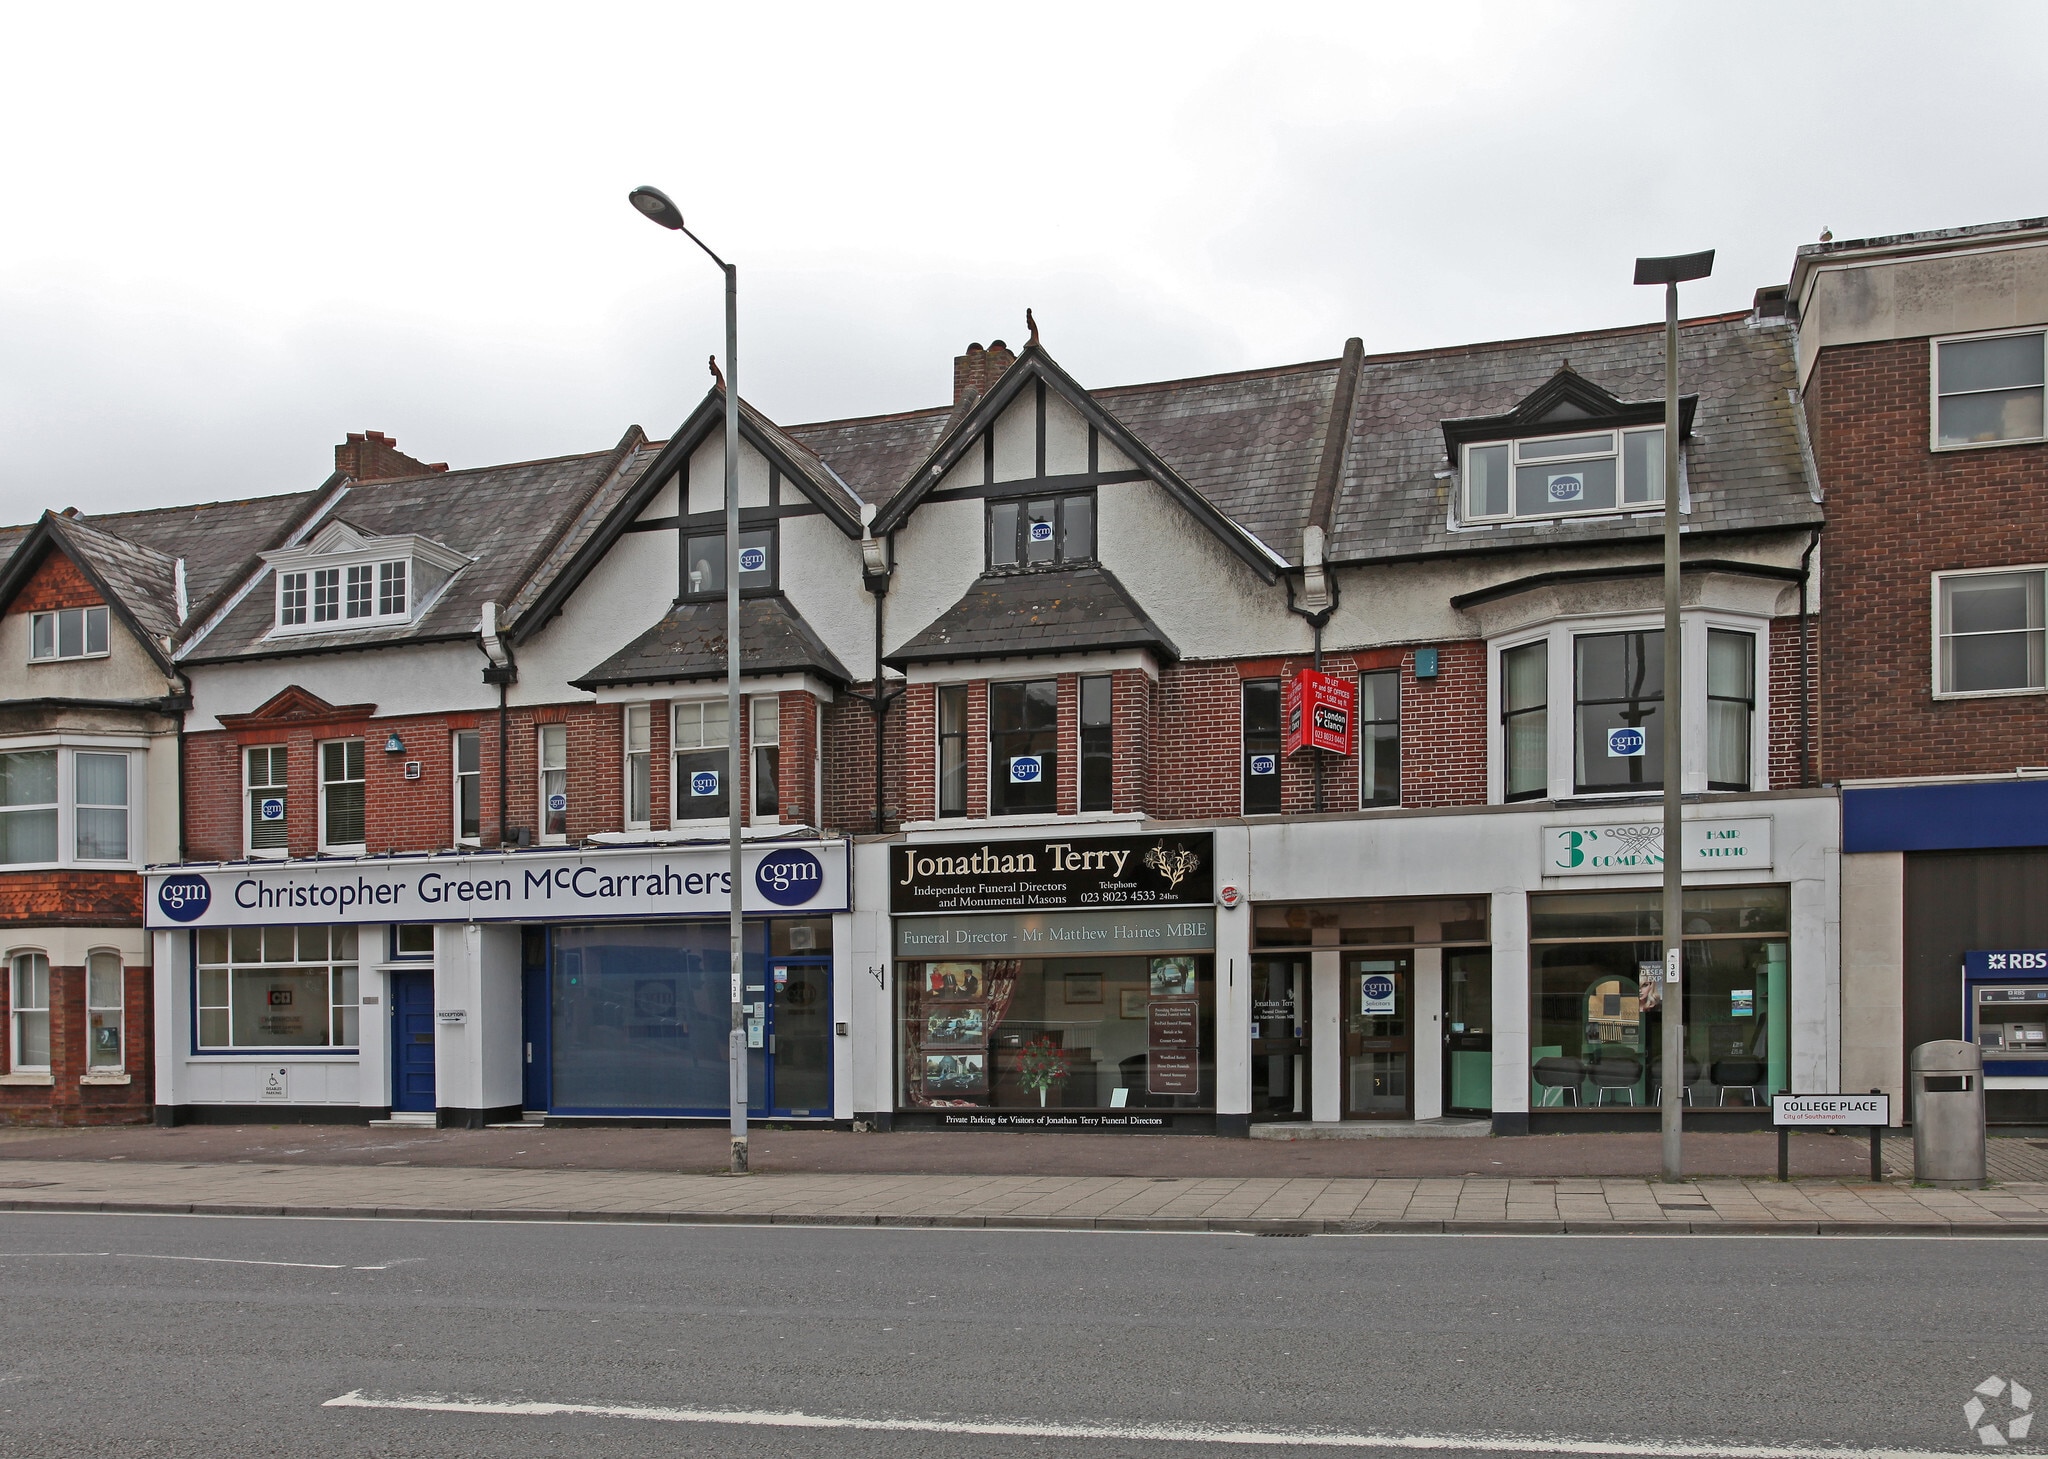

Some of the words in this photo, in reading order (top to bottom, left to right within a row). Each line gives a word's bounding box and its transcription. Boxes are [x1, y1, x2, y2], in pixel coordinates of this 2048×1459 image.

[1550, 482, 1580, 496] cgm
[1032, 528, 1050, 538] cgm
[740, 554, 762, 566] cgm
[1324, 710, 1345, 723] London
[1324, 720, 1343, 733] Clancy
[1610, 736, 1642, 751] cgm
[1012, 764, 1039, 777] cgm
[1252, 762, 1273, 771] cgm
[693, 779, 716, 791] cgm
[263, 804, 282, 815] cgm
[1706, 830, 1740, 840] HAIR
[1699, 847, 1748, 858] STUDIO
[900, 846, 1036, 886] Jonathan
[1046, 844, 1130, 878] Terry
[1592, 854, 1664, 868] COMPAN
[760, 860, 818, 892] cgm
[234, 876, 406, 914] Christopher
[418, 872, 511, 902] Green
[524, 864, 732, 900] McCarrahers
[914, 885, 976, 896] Independent
[979, 884, 1016, 894] Funeral
[1019, 882, 1067, 892] Directors
[1099, 881, 1137, 890] Telephone
[161, 882, 207, 909] cgm
[939, 897, 957, 908] and
[960, 895, 1025, 907] Monumental
[1028, 895, 1067, 905] Masons
[1081, 892, 1099, 902] 023
[1103, 892, 1128, 902] 8023
[1130, 891, 1156, 901] 4533
[1159, 892, 1179, 900] 24hrs
[904, 930, 949, 944] Funeral
[956, 930, 1008, 944] Director
[1023, 929, 1043, 942] Mr
[1050, 926, 1108, 941] Matthew
[1114, 924, 1160, 938] Haines
[1167, 923, 1207, 937] MBIE
[2010, 953, 2046, 969] RBS
[1363, 983, 1392, 996] cgm
[1254, 1000, 1279, 1008] Jonathan
[1282, 1000, 1295, 1008] Terry
[1784, 1102, 1836, 1111] COLLEGE
[1840, 1102, 1877, 1111] PLACE
[946, 1116, 967, 1124] Private
[970, 1116, 995, 1125] Parking
[998, 1116, 1007, 1124] for
[1010, 1116, 1034, 1124] Visitors
[1036, 1116, 1044, 1124] of
[1046, 1116, 1077, 1126] Jonathan
[1080, 1116, 1098, 1126] Terry
[1101, 1116, 1127, 1124] Funeral
[1130, 1116, 1162, 1125] Directors
